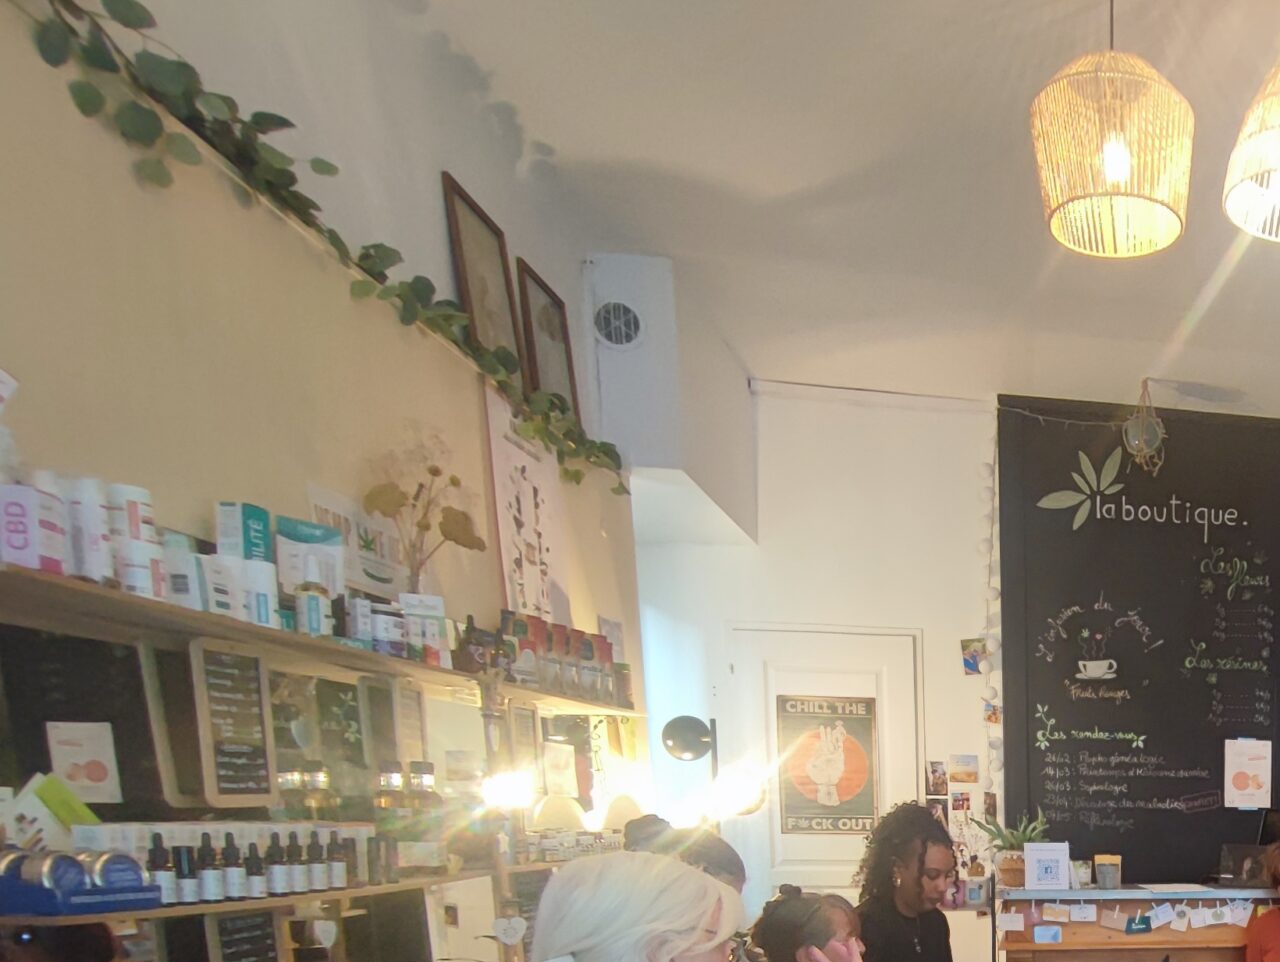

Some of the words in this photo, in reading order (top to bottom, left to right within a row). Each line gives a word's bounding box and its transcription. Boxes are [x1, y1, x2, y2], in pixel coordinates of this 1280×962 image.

[4, 501, 29, 550] CBD
[1200, 545, 1232, 576] Les
[1227, 557, 1271, 601] fleurs
[1185, 638, 1213, 669] Les
[785, 701, 832, 713] CHILL
[835, 702, 866, 715] THE
[1037, 718, 1067, 742] Les
[1070, 726, 1138, 741] rendez-vous
[838, 818, 873, 830] OUT
